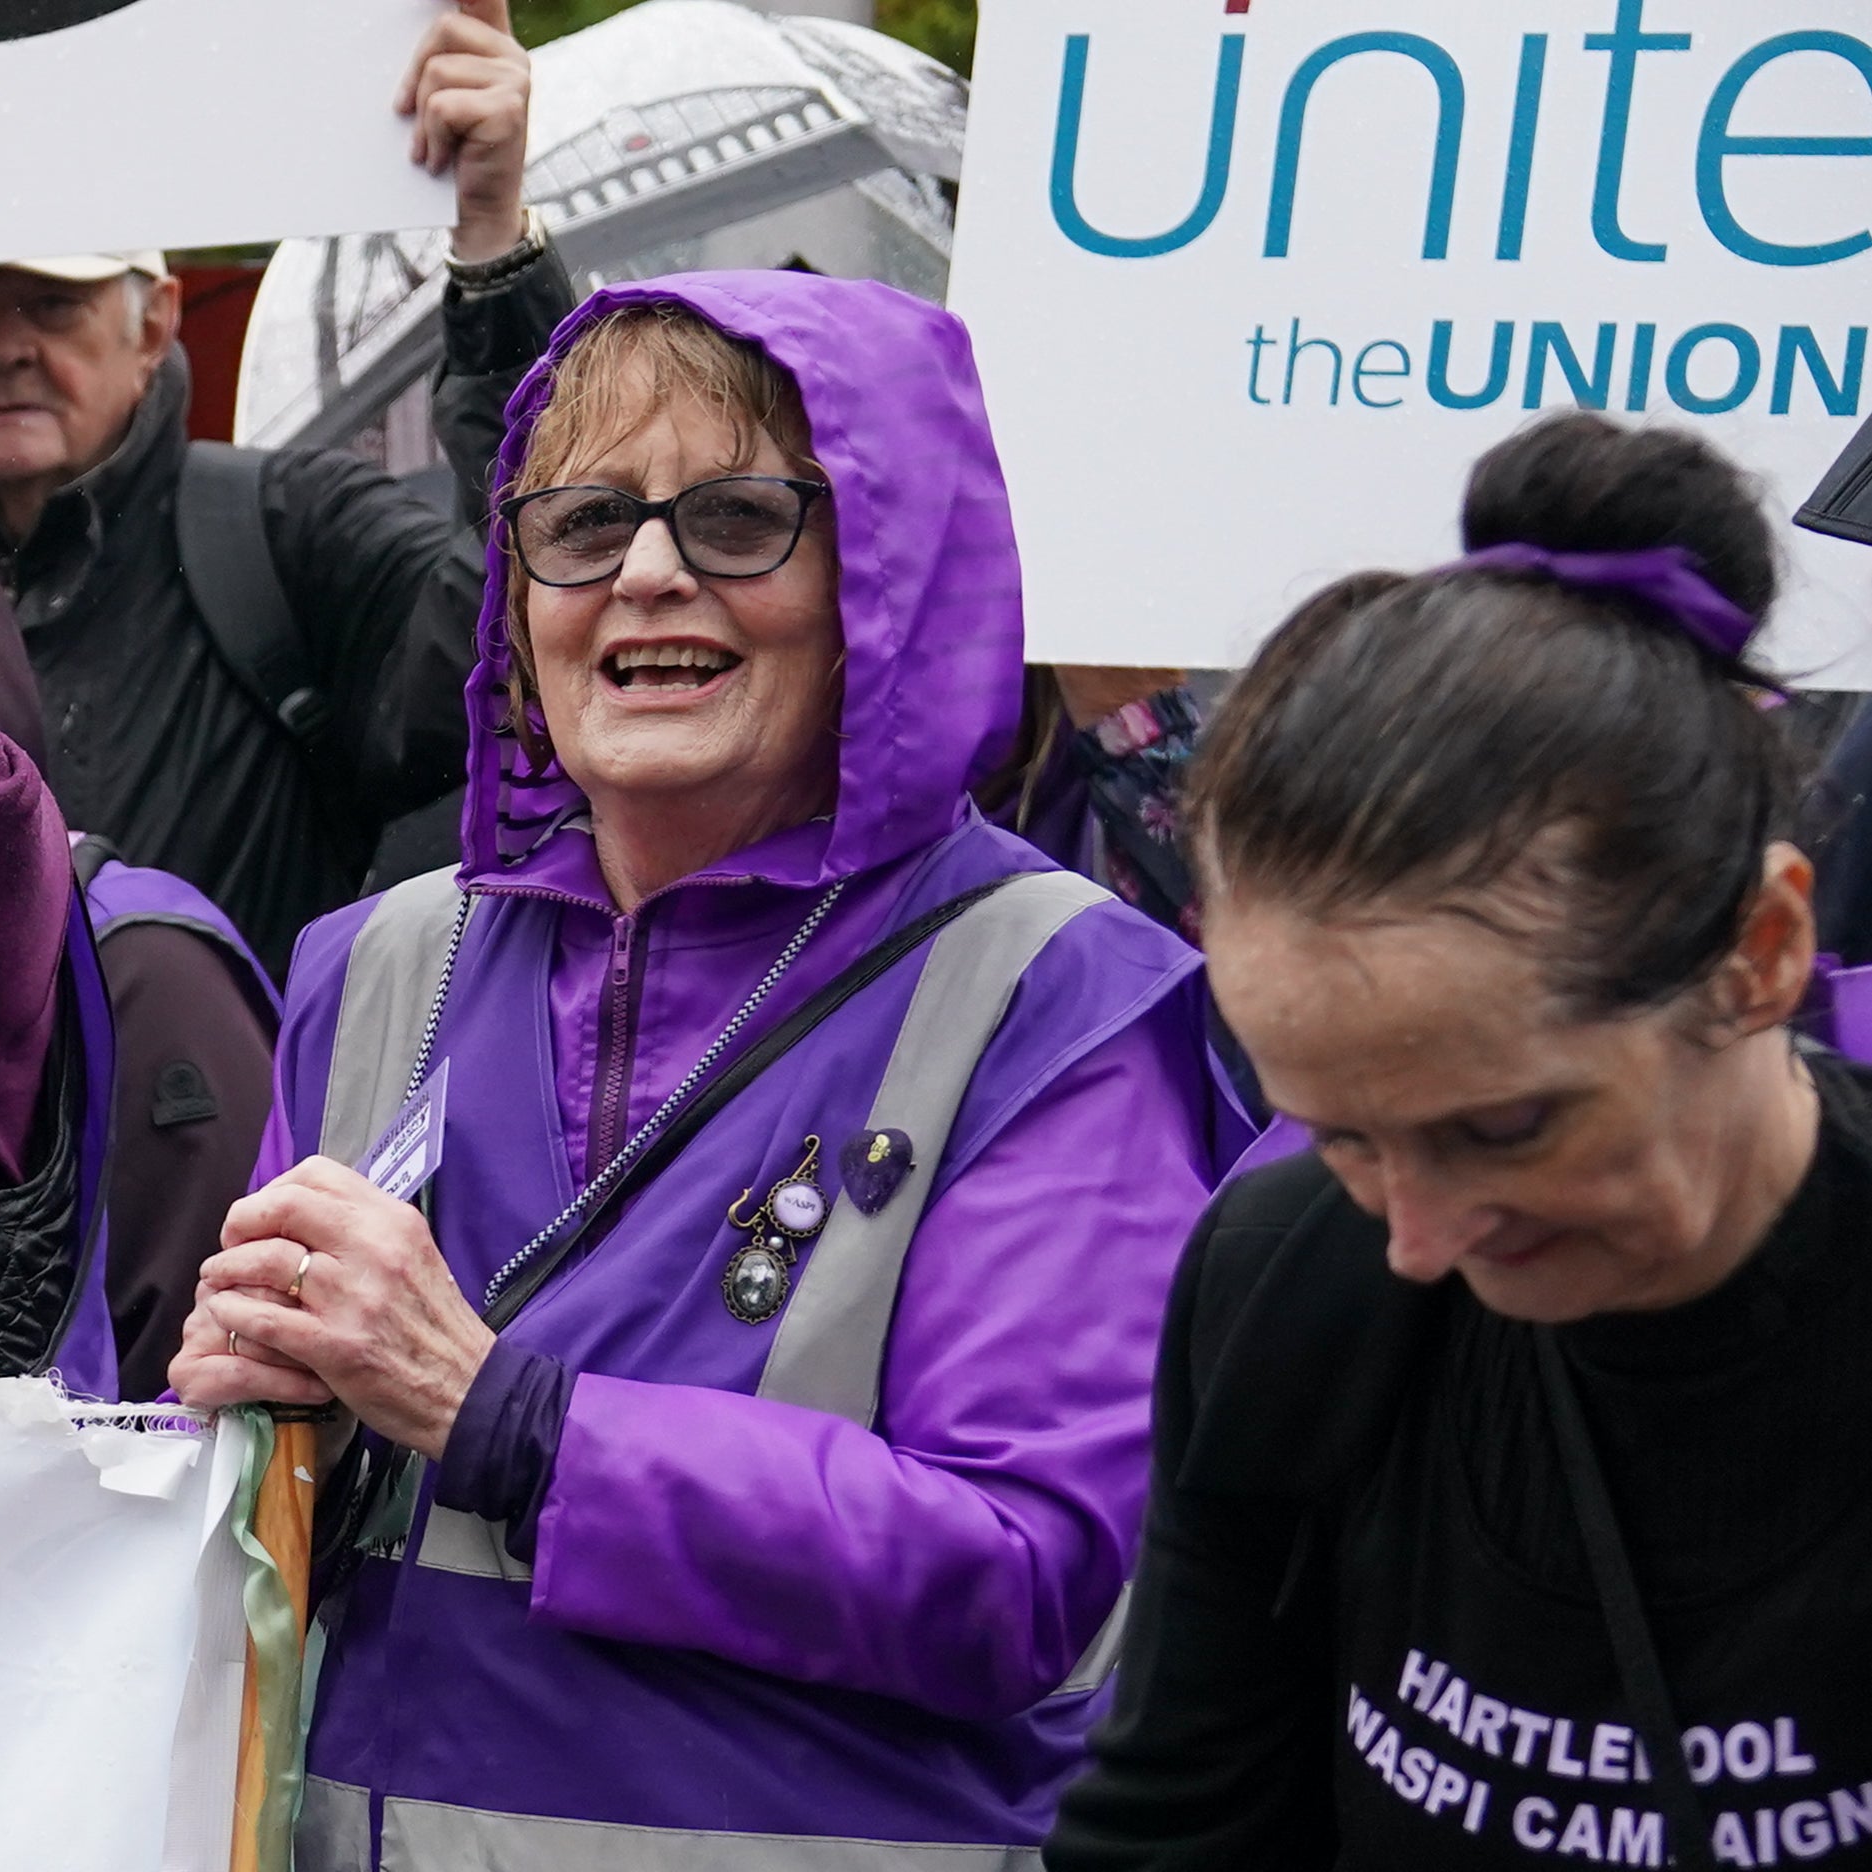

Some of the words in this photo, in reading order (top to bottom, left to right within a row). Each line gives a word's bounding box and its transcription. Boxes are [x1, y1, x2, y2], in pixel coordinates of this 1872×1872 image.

[1049, 0, 1872, 267] unite
[1347, 1682, 1491, 1834] WASPI
[1511, 1780, 1872, 1870] CAMAIGN
